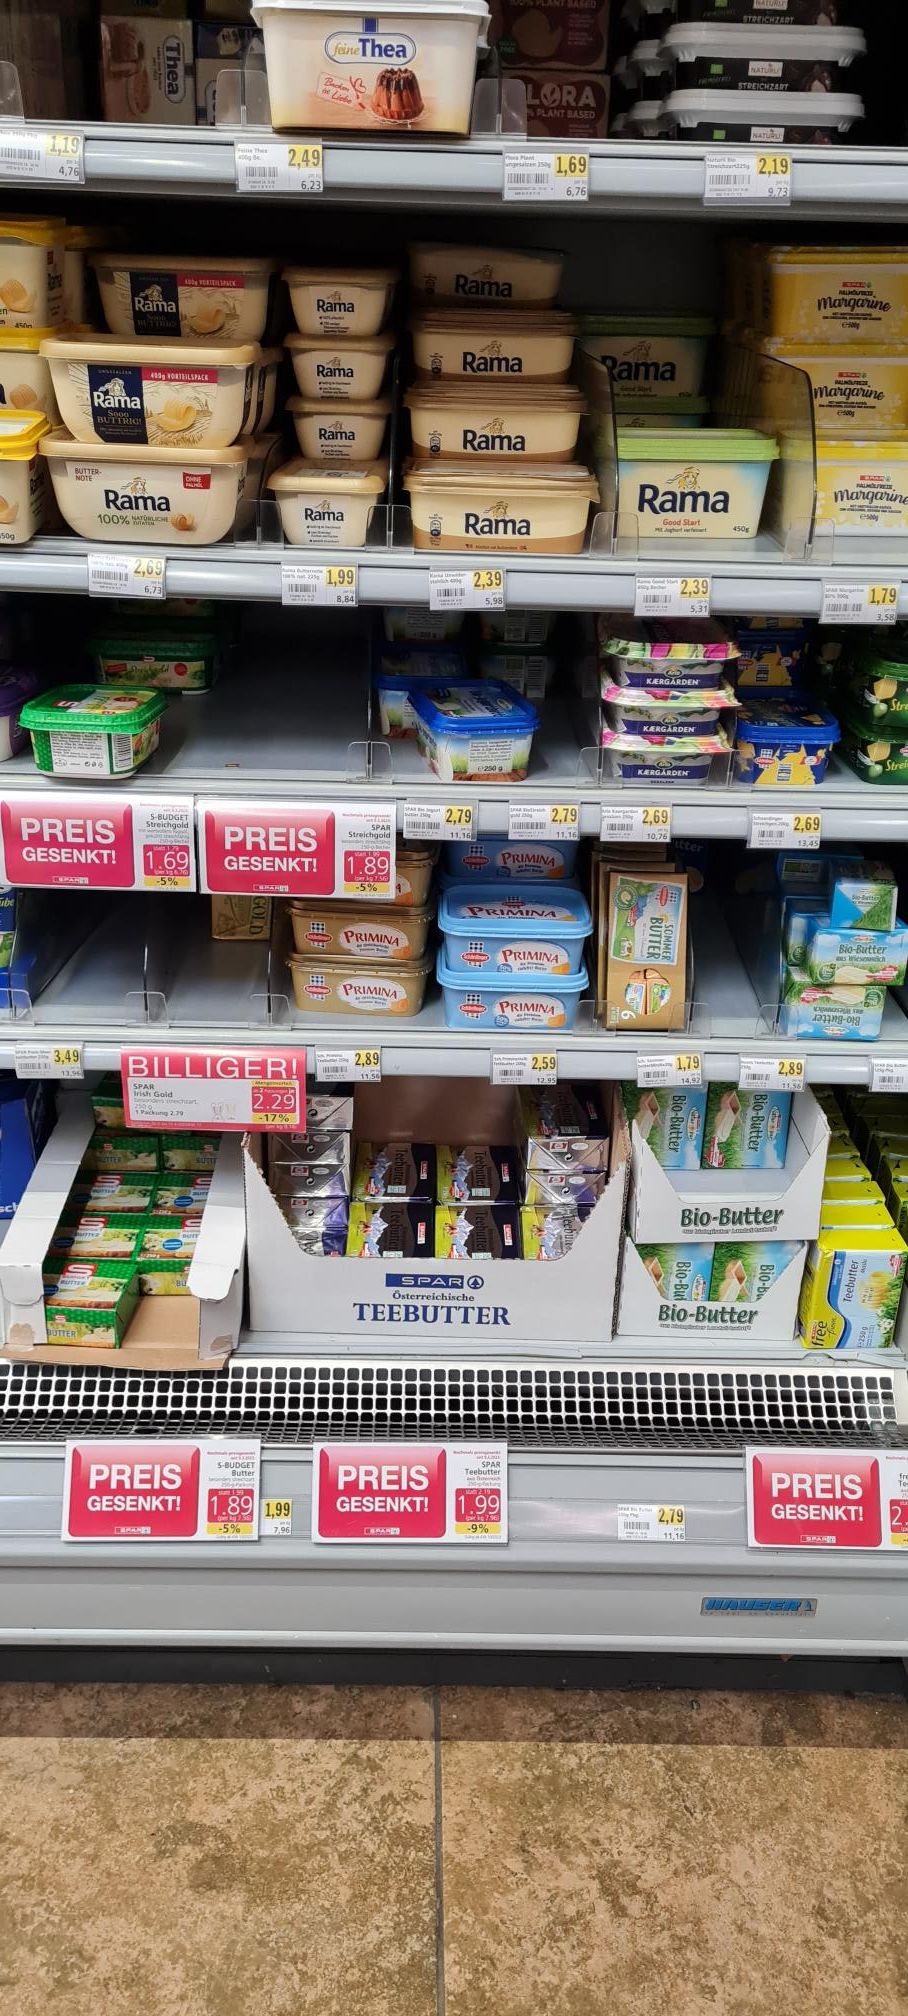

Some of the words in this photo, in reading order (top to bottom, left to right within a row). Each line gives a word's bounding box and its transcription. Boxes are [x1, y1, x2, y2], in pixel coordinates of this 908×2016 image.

[743, 16, 794, 24] STREICHZART
[332, 43, 360, 56] feine
[358, 38, 406, 58] Thea
[166, 42, 180, 95] Thea
[738, 82, 788, 90] STREICHZART
[536, 109, 566, 118] PLANT
[567, 109, 596, 118] BASED
[50, 136, 79, 156] 1,19
[288, 149, 320, 169] 2,49
[556, 156, 586, 176] 1,69
[59, 166, 78, 176] 4,76
[759, 158, 788, 177] 2,19
[301, 181, 321, 191] 6,23
[566, 187, 586, 196] 6,76
[768, 188, 788, 197] 9,73
[455, 274, 512, 297] Rama
[134, 297, 176, 312] Rama
[317, 299, 354, 312] Rama
[817, 296, 892, 312] Margarine
[463, 352, 523, 373] Rama
[600, 355, 676, 382] Rama
[167, 373, 208, 381] VORTEILSPACK
[317, 365, 354, 377] Rama
[93, 392, 142, 409] Rama
[814, 385, 885, 400] Margarine
[97, 416, 142, 425] BUTTRIG!
[318, 428, 355, 440] Rama
[463, 429, 525, 452] Rama
[104, 489, 170, 512] Rama
[638, 484, 730, 514] Rama
[834, 489, 908, 506] Margarine
[98, 514, 130, 526] 100%
[304, 508, 344, 521] Rama
[682, 518, 700, 526] Start
[464, 513, 530, 536] Rama
[134, 559, 162, 577] 2,69
[327, 569, 354, 587] 1,99
[474, 571, 502, 590] 2,39
[144, 586, 162, 594] 6,73
[681, 580, 708, 597] 2,39
[870, 588, 896, 605] 1,79
[690, 605, 707, 613] 5,31
[150, 813, 188, 821] S-BUDGET
[446, 809, 471, 825] 2,79
[552, 808, 577, 824] 2,79
[642, 809, 668, 825] 2,69
[20, 818, 116, 844] PREIS
[146, 821, 189, 830] Streichgold
[794, 817, 820, 832] 2,69
[224, 826, 318, 852] PREIS
[22, 847, 116, 864] GESENKT!
[146, 851, 188, 870] 1.69
[501, 852, 556, 867] PRIMINA
[224, 856, 317, 872] GESENKT!
[348, 857, 388, 875] 1.89
[156, 877, 178, 885] -5%
[356, 883, 377, 892] -5%
[467, 906, 557, 917] PRIMINA
[344, 930, 399, 947] PRIMINA
[646, 917, 663, 959] BUTTER
[662, 924, 674, 960] SOMMER
[502, 949, 559, 963] PRIMINA
[839, 944, 887, 955] Bio-Butter
[342, 984, 397, 999] PRIMINA
[499, 1001, 554, 1015] PRIMINA
[812, 1013, 860, 1026] Bio-Butter
[54, 1050, 78, 1064] 3,49
[355, 1052, 379, 1068] 2,89
[532, 1057, 556, 1072] 2,59
[677, 1056, 699, 1071] 1,79
[128, 1056, 297, 1079] BILLIGER!
[778, 1062, 802, 1076] 2,89
[253, 1094, 295, 1110] 2.29
[258, 1114, 289, 1122] -17%
[669, 1095, 687, 1153] Bio-Butter
[748, 1094, 768, 1152] Bio-Butter
[475, 1152, 486, 1188] Teebutter
[681, 1207, 784, 1227] Bio-Butter
[476, 1210, 488, 1251] Teebutter
[401, 1277, 462, 1286] SPAR
[843, 1260, 859, 1302] Teebutter
[392, 1290, 474, 1302] Österreichische
[353, 1303, 511, 1326] TEEBUTTER
[658, 1304, 758, 1324] Bio-Butter
[47, 1329, 76, 1337] BUTTER
[812, 1321, 828, 1346] free
[89, 1464, 182, 1489] PREIS
[337, 1465, 429, 1491] PREIS
[772, 1473, 863, 1499] PREIS
[87, 1496, 180, 1511] GESENKT!
[211, 1496, 252, 1515] 1.89
[265, 1502, 290, 1520] 1,99
[336, 1497, 429, 1512] GESENKT!
[458, 1495, 500, 1514] 1.99
[659, 1509, 683, 1525] 2,79
[772, 1504, 863, 1521] GESENKT!
[219, 1524, 240, 1533] -5%
[467, 1524, 488, 1533] -9%
